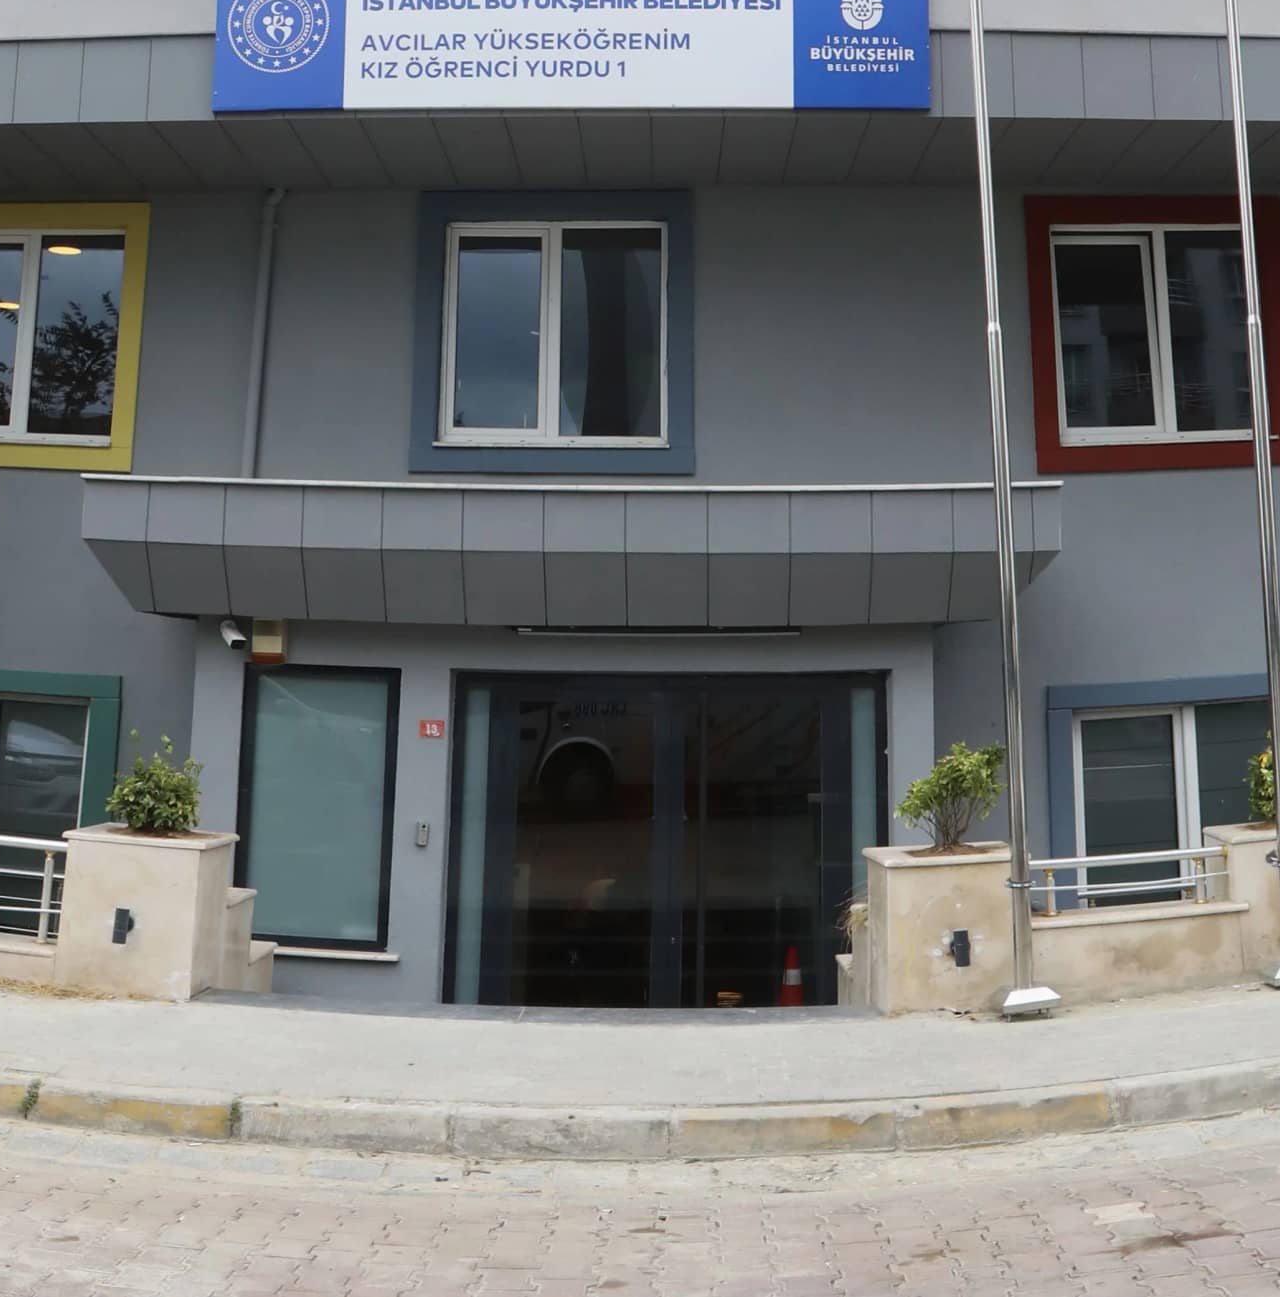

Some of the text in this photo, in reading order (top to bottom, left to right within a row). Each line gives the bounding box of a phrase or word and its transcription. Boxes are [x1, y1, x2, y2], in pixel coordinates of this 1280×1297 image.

[361, 28, 690, 51] AVCILAR YÜKSEKÖĞRENİM
[826, 35, 899, 45] İSTANBUL
[810, 45, 915, 62] BÜYÜKŞEHİR
[361, 55, 625, 79] KIZ ÖĞRENCİ YURDU 1
[827, 63, 899, 73] BELEDİYESİ
